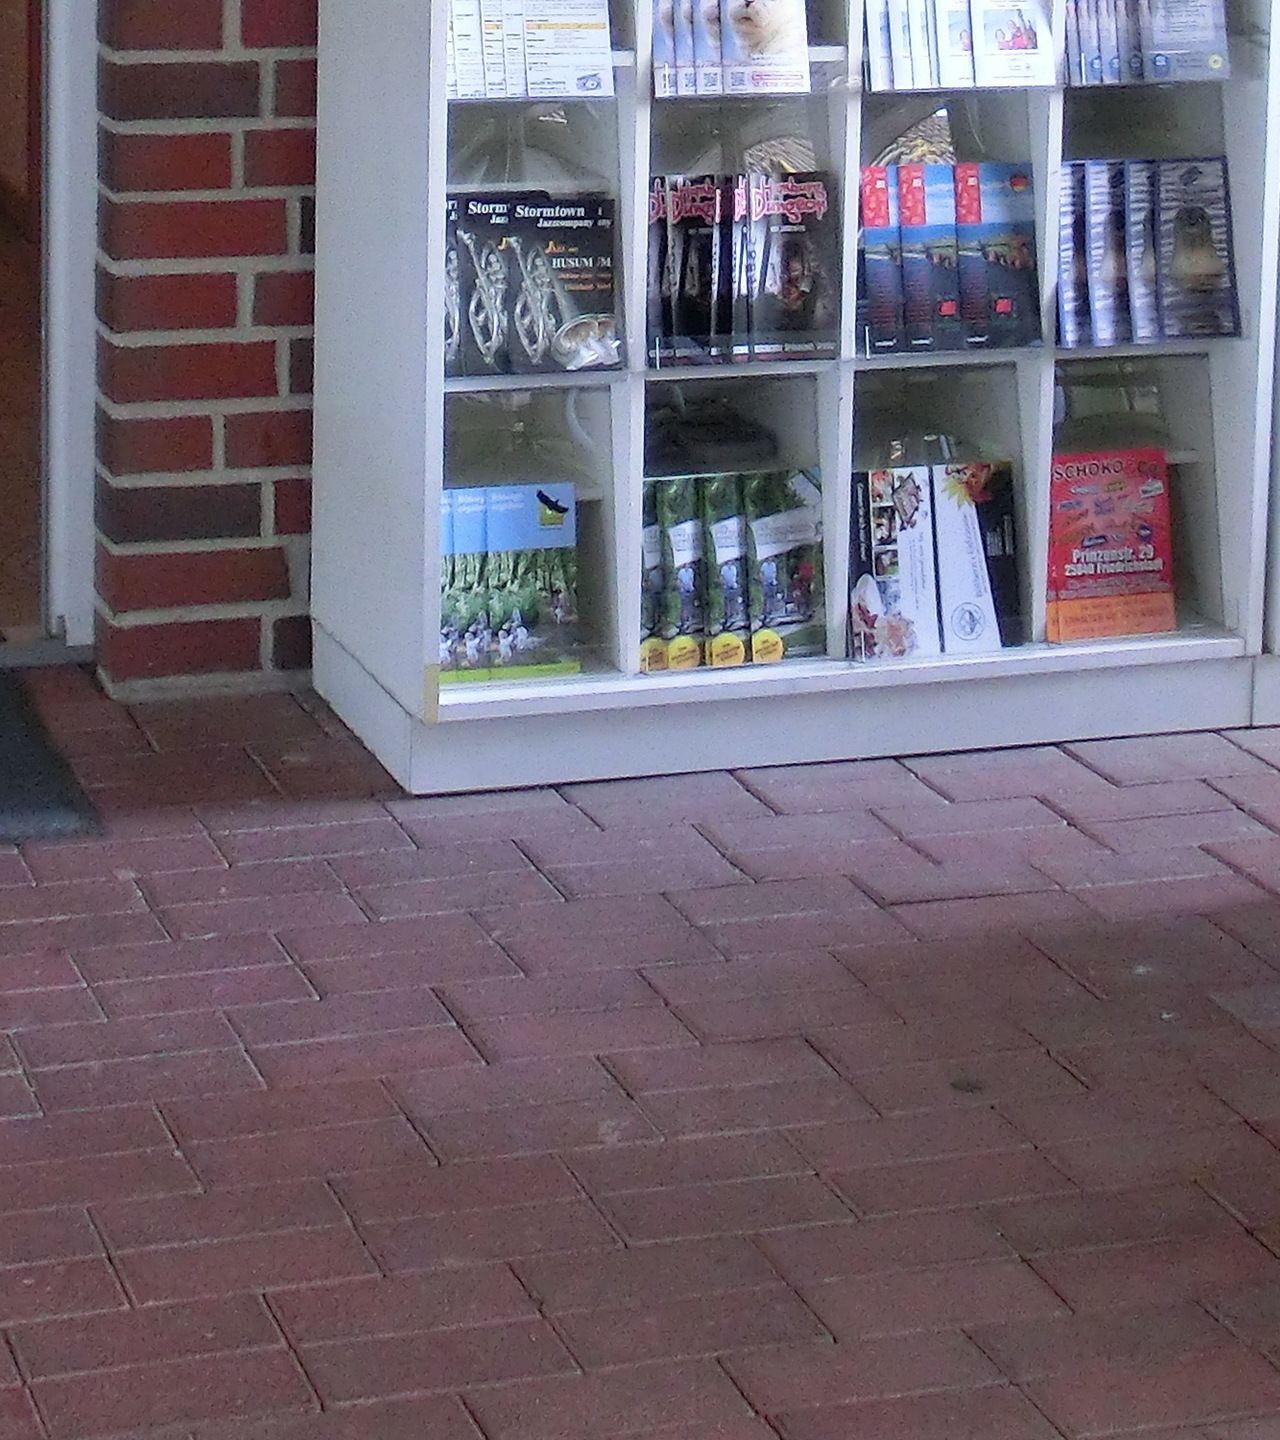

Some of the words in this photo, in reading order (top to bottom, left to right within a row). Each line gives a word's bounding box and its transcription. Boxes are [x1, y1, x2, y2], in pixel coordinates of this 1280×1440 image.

[515, 205, 585, 218] Stormtown
[552, 257, 594, 270] HUSUM
[1053, 460, 1124, 481] SCHOKO
